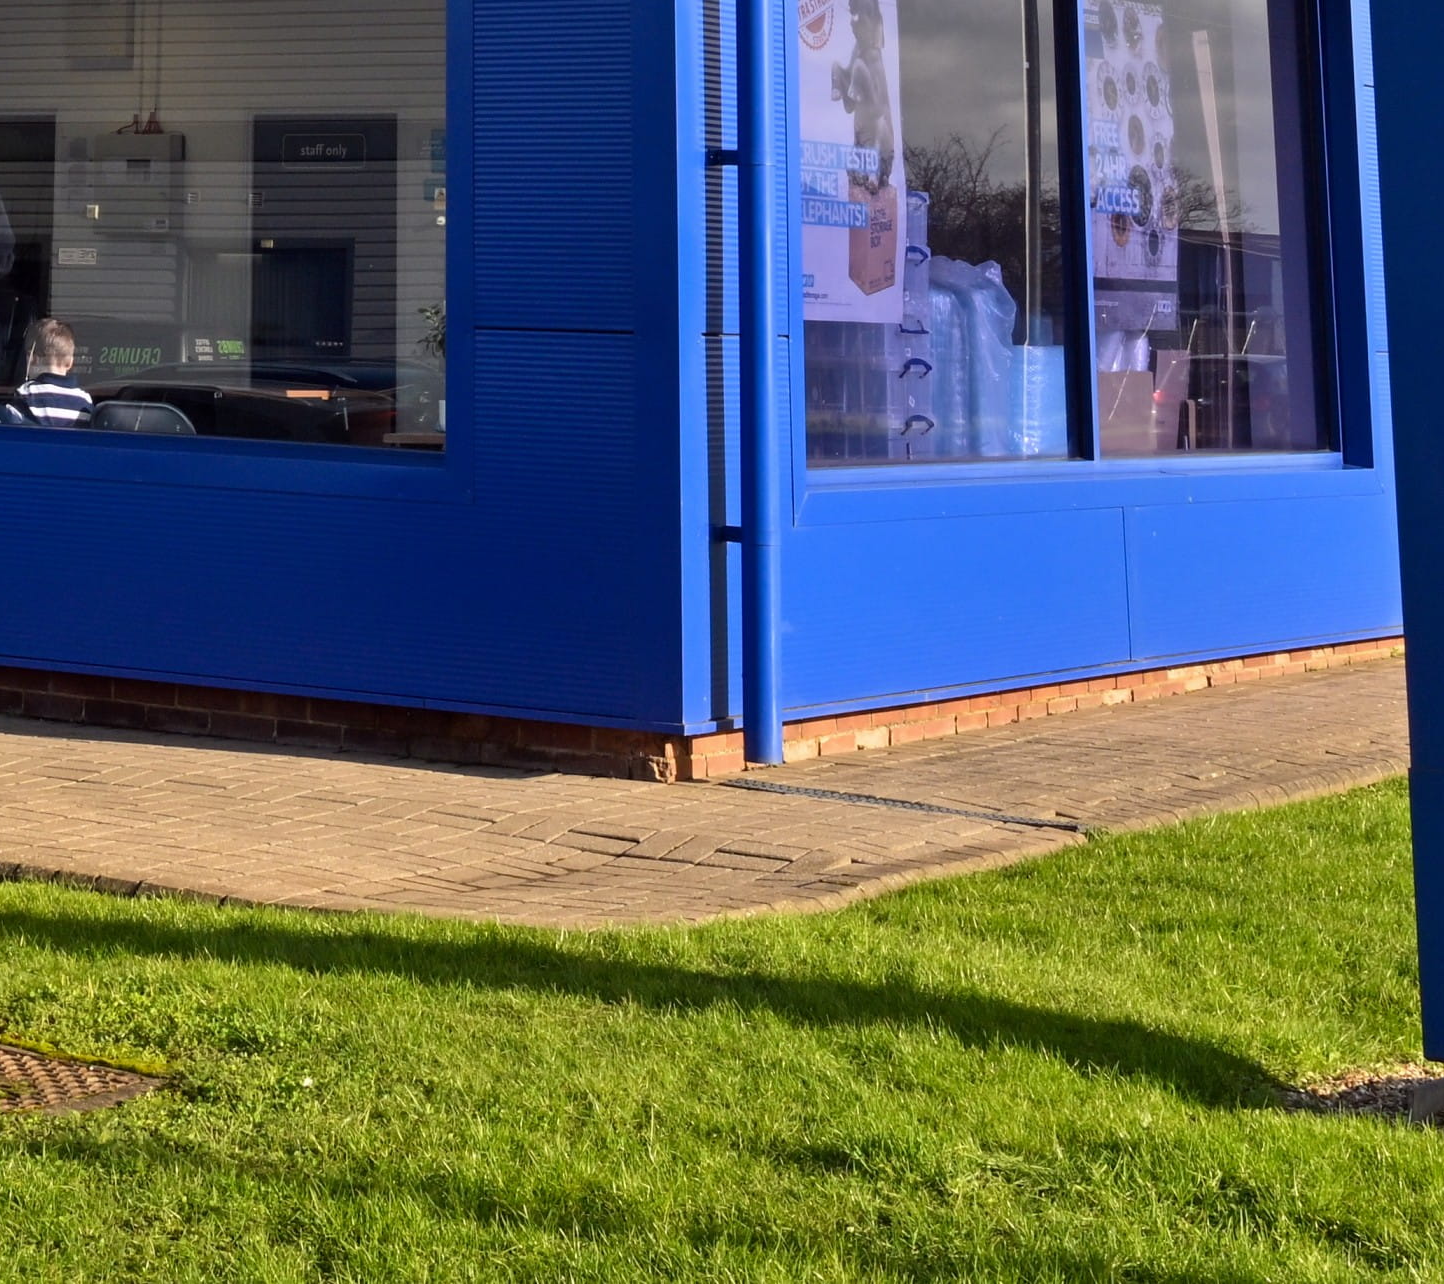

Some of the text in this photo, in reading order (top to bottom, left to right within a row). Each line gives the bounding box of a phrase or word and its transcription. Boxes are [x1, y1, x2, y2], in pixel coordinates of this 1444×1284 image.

[1094, 123, 1119, 146] FREE
[300, 143, 347, 159] staff only
[841, 147, 879, 174] TESTED
[1094, 154, 1130, 178] 24HR
[815, 173, 838, 197] THE
[1096, 187, 1141, 215] ACCESS
[870, 219, 893, 235] STORAGE
[870, 235, 881, 249] BOX
